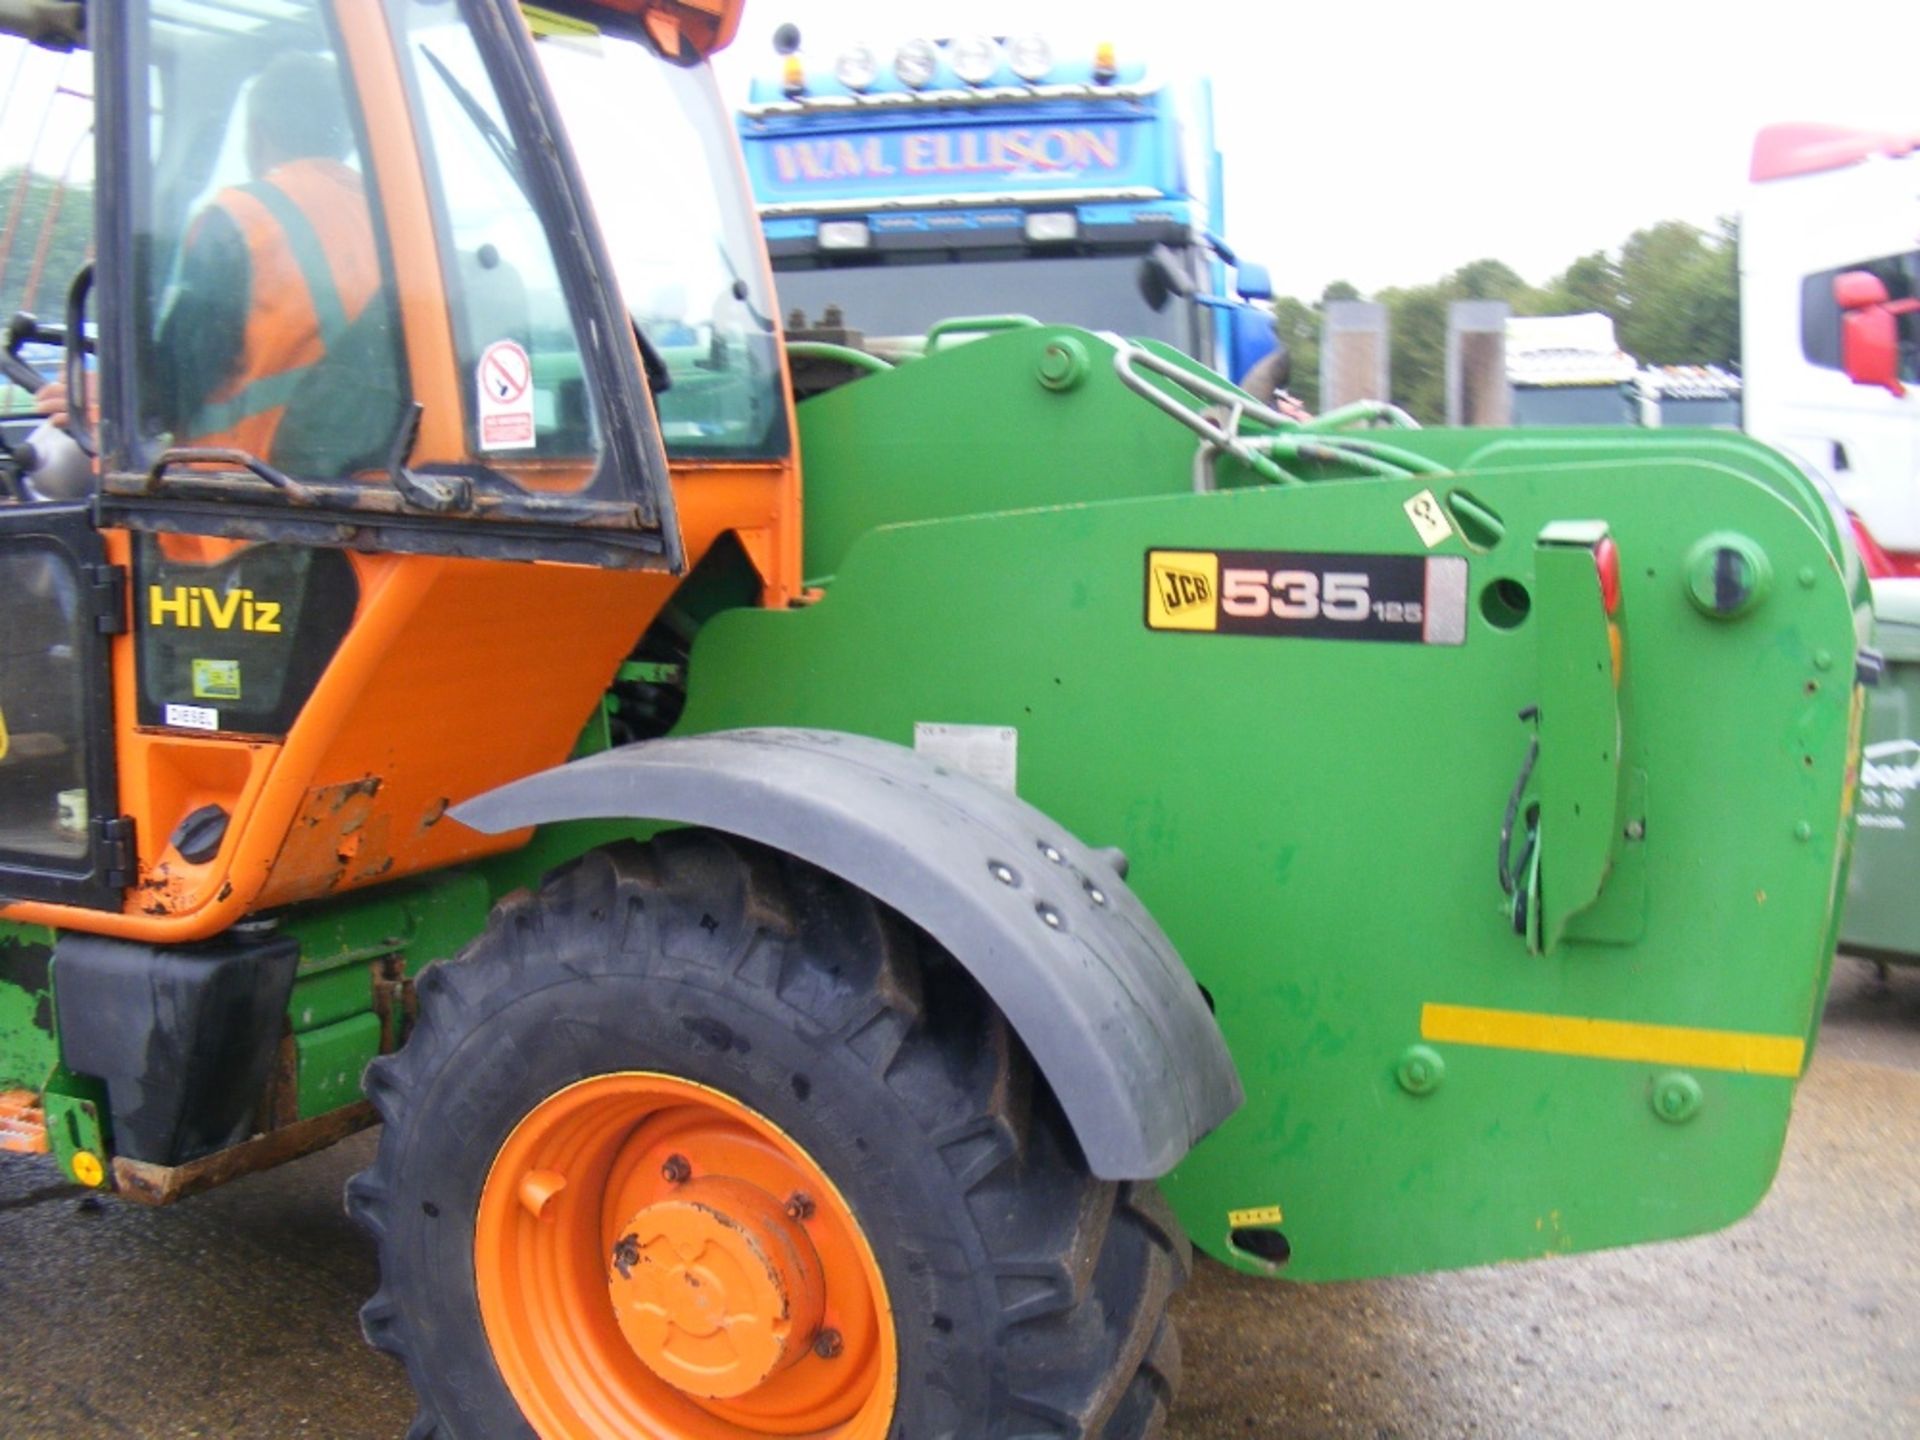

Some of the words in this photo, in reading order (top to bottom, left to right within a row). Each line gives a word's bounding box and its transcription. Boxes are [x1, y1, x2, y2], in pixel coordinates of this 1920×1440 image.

[904, 127, 1119, 174] ELLISON
[149, 584, 282, 633] HiViz
[1165, 571, 1208, 608] JCB
[1221, 568, 1371, 621] 535
[1372, 601, 1423, 623] 125
